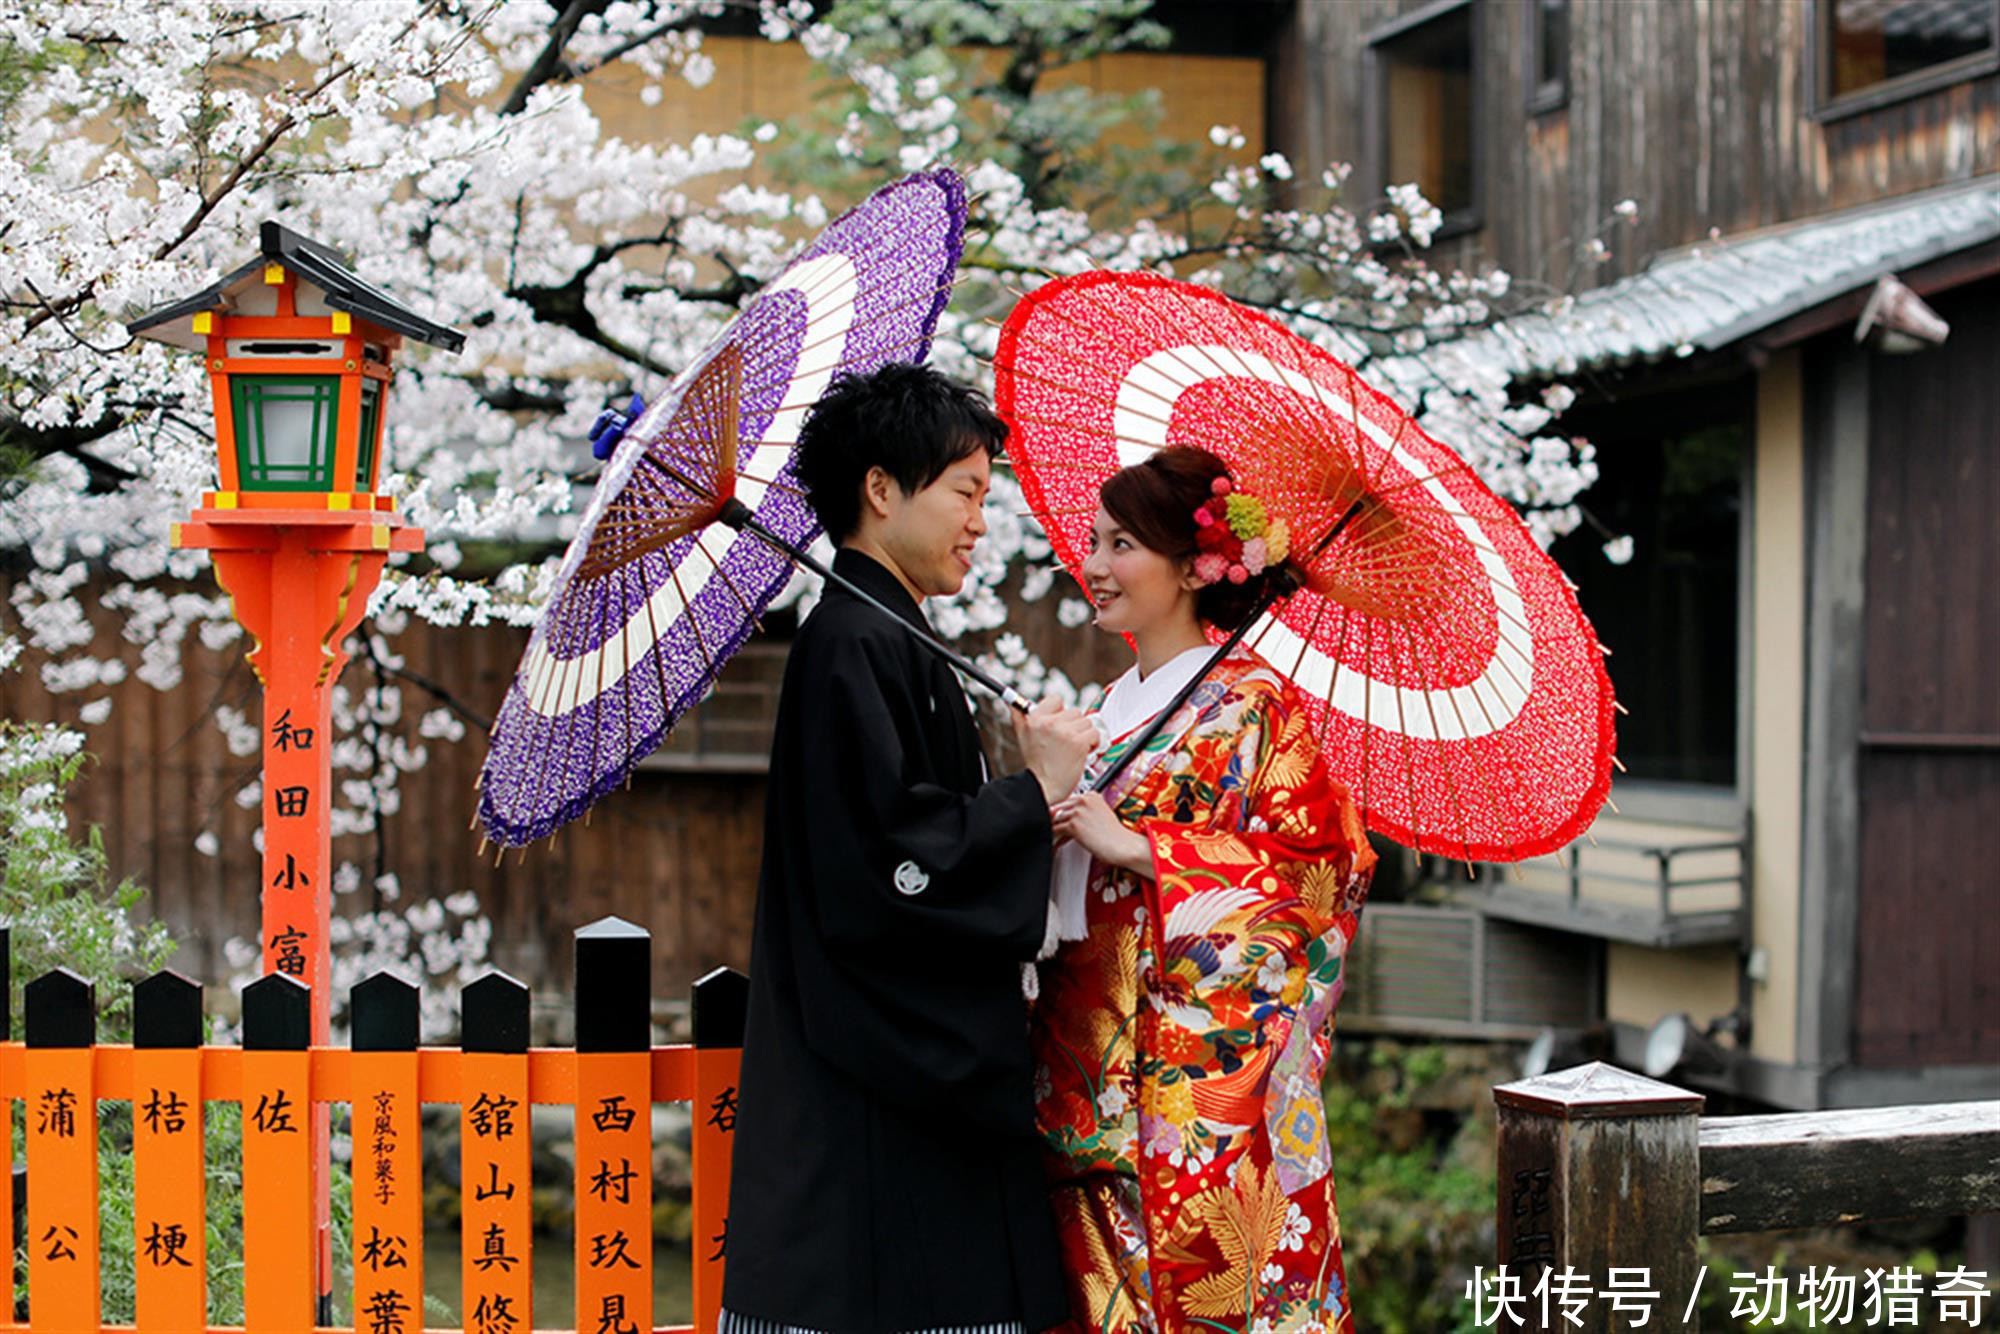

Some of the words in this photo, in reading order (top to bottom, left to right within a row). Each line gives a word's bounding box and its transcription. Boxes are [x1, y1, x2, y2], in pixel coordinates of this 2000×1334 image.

[271, 708, 314, 975] 和田小富
[37, 1087, 79, 1261] 蒲公
[142, 1088, 193, 1267] 桔梗
[251, 1089, 298, 1134] 佐
[372, 1091, 397, 1206] 京風和菓子
